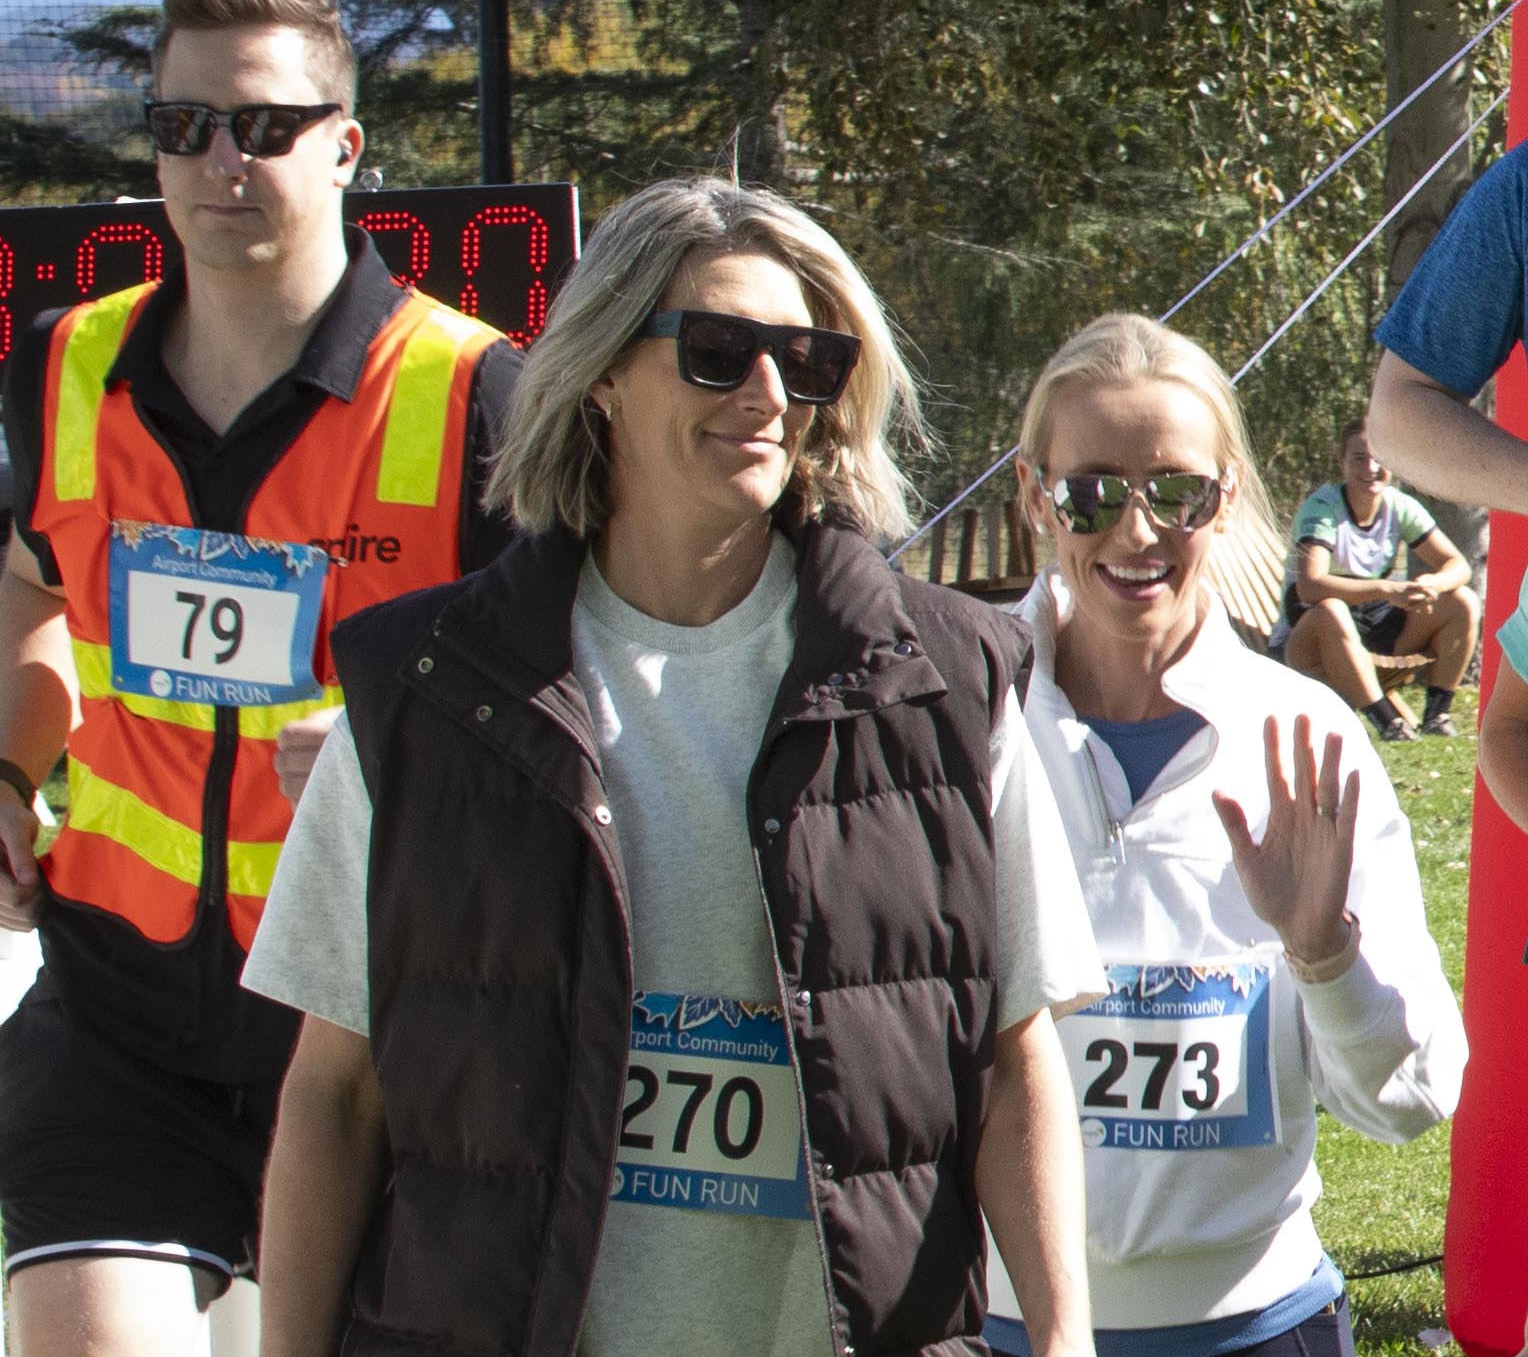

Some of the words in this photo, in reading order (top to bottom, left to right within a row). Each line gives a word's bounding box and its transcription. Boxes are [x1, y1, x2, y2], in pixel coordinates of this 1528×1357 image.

[153, 556, 198, 575] Airport
[201, 561, 276, 587] Community
[176, 591, 243, 664] 79
[176, 676, 219, 699] FUN
[224, 683, 272, 703] RUN
[1141, 997, 1226, 1015] Community
[630, 1030, 672, 1047] rport
[678, 1033, 779, 1062] Community
[1084, 1039, 1220, 1111] 273
[620, 1065, 764, 1160] 270
[1114, 1122, 1164, 1146] FUN
[1174, 1123, 1220, 1147] RUN
[632, 1172, 690, 1200] FUN
[701, 1179, 759, 1208] RUN
